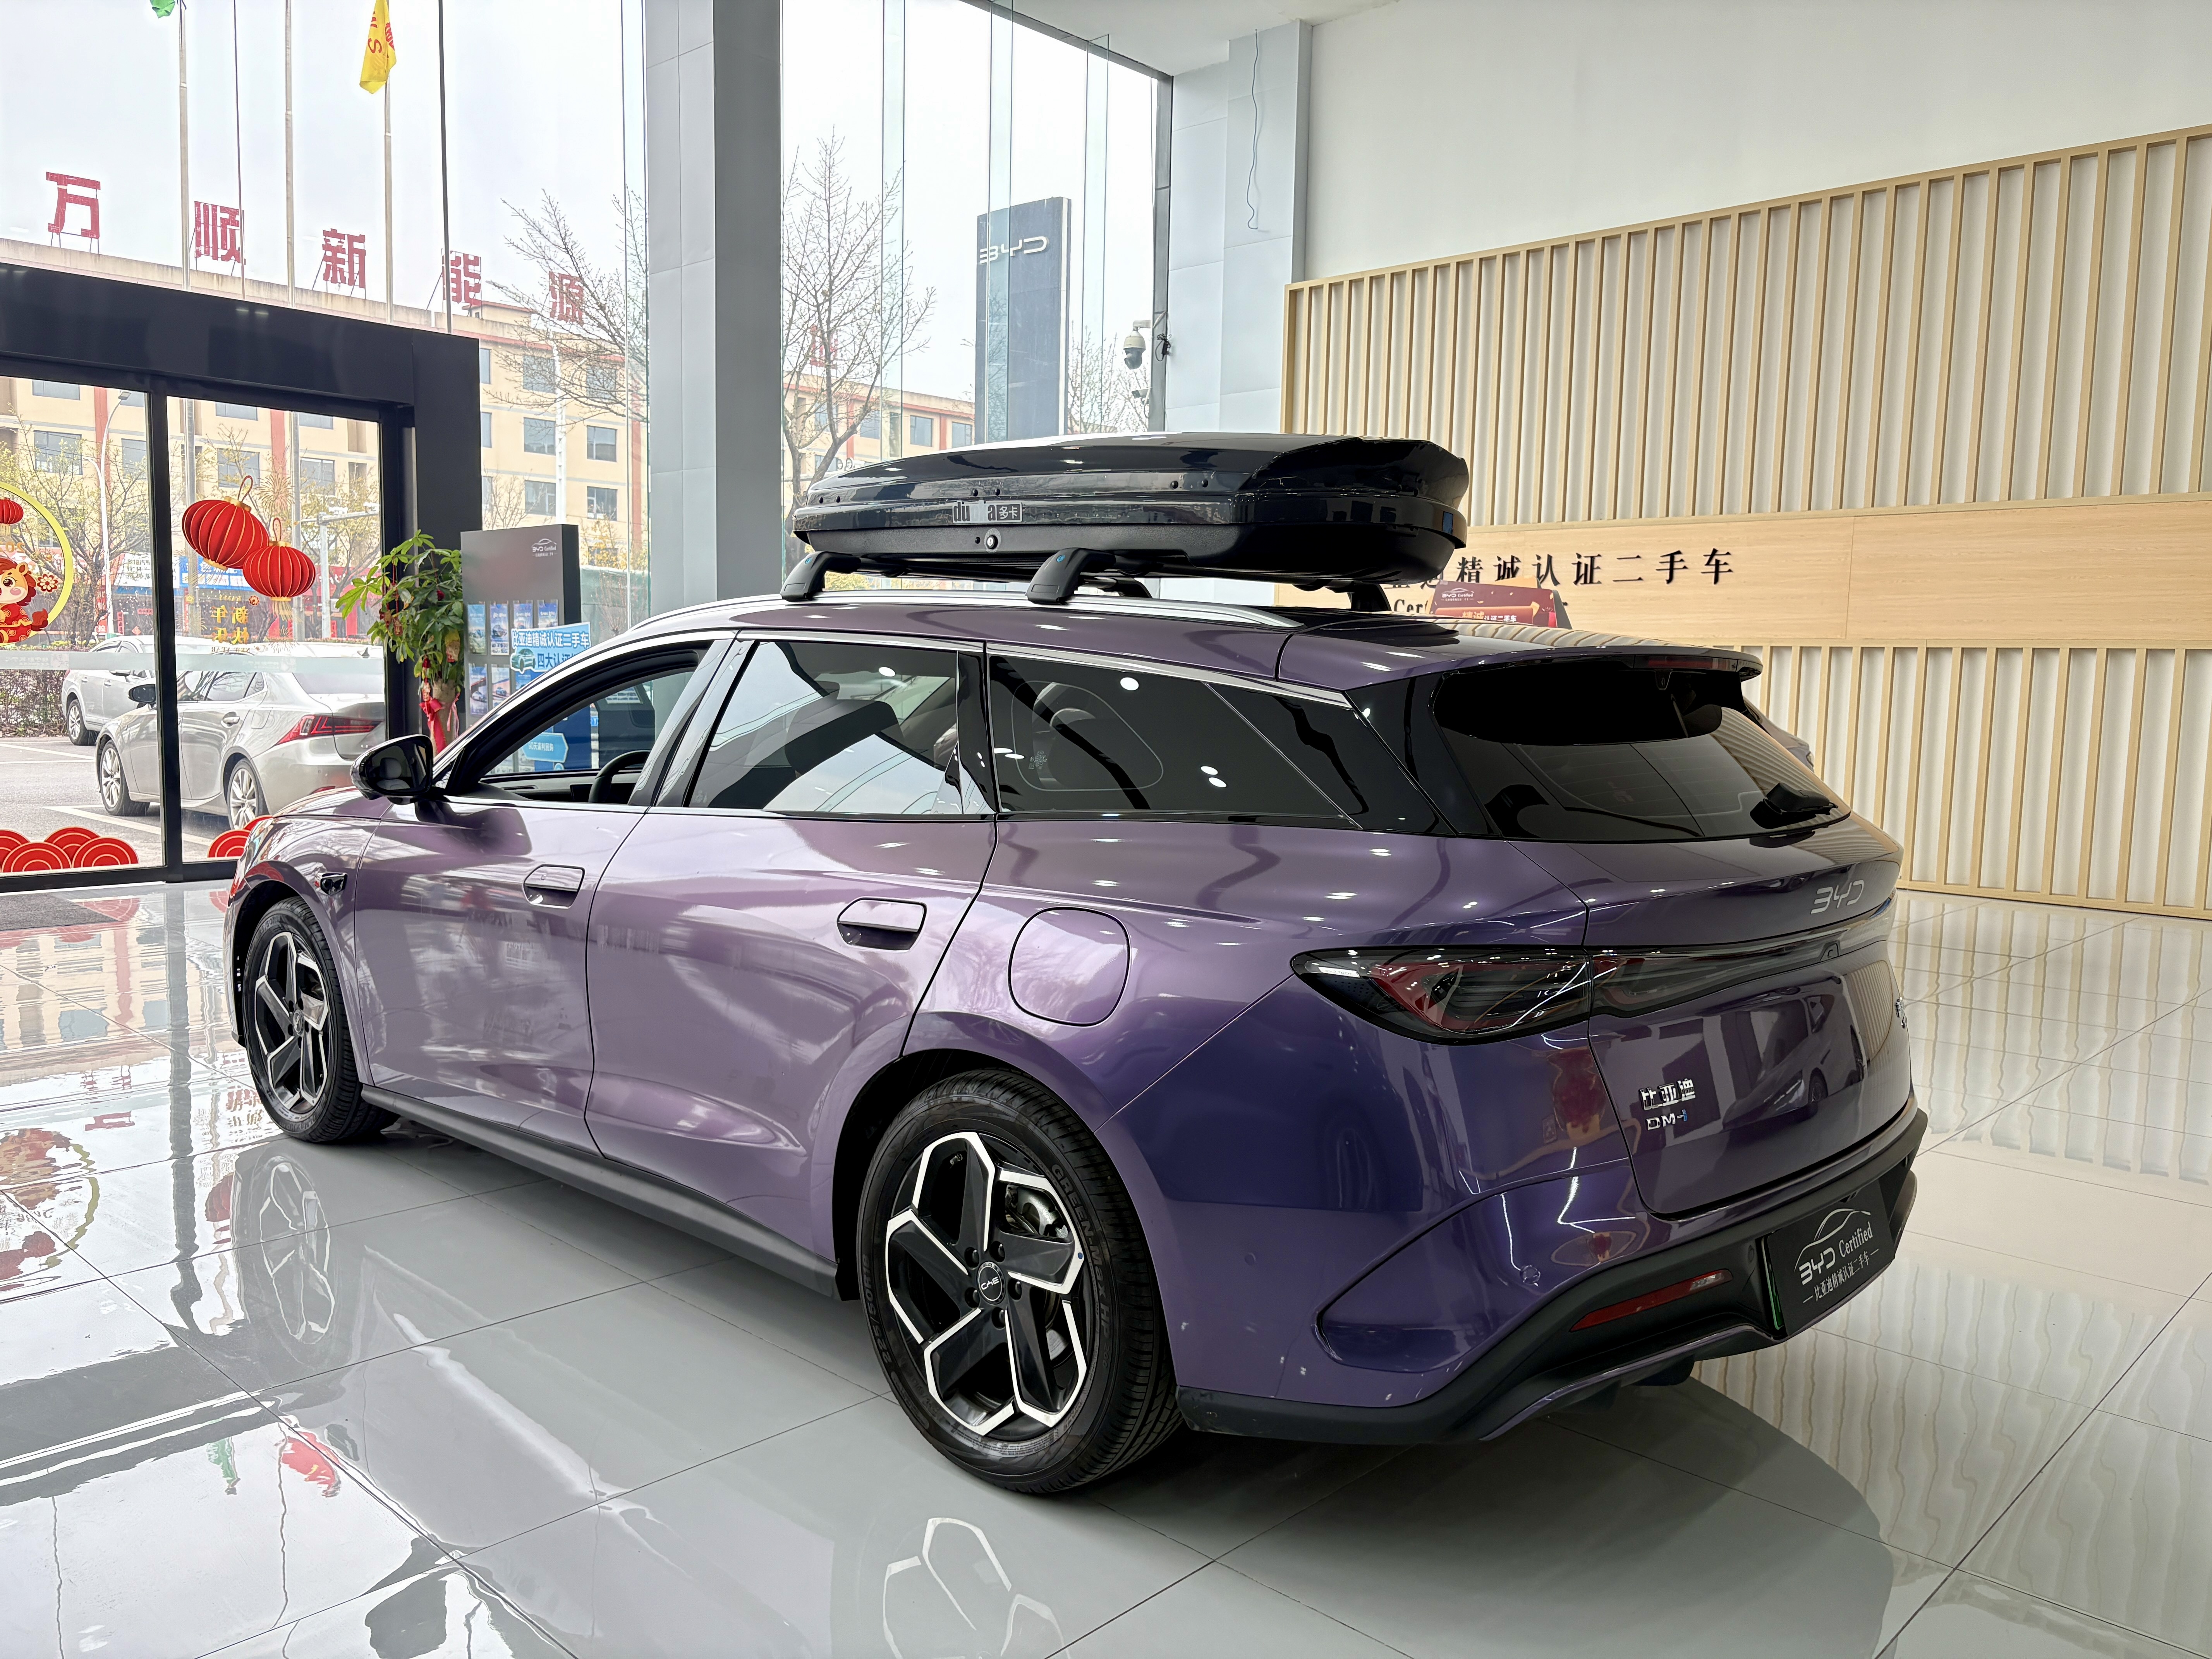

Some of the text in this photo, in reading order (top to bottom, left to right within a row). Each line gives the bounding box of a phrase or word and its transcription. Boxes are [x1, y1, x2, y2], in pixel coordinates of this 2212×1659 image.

[46, 171, 585, 325] 万顺新能源
[979, 235, 1049, 264] BYD
[999, 506, 1018, 520] 多卡
[1384, 548, 1733, 589] 精诚认证二手车
[513, 632, 589, 649] 比亚迪精诚认证二手车
[537, 653, 575, 668] 四大认证
[1810, 879, 1864, 915] BYD
[1639, 1078, 1696, 1111] 比亚迪
[1799, 1221, 1873, 1286] BYD Certified
[1814, 1250, 1870, 1302] 比亚迪精诚认证二手车
